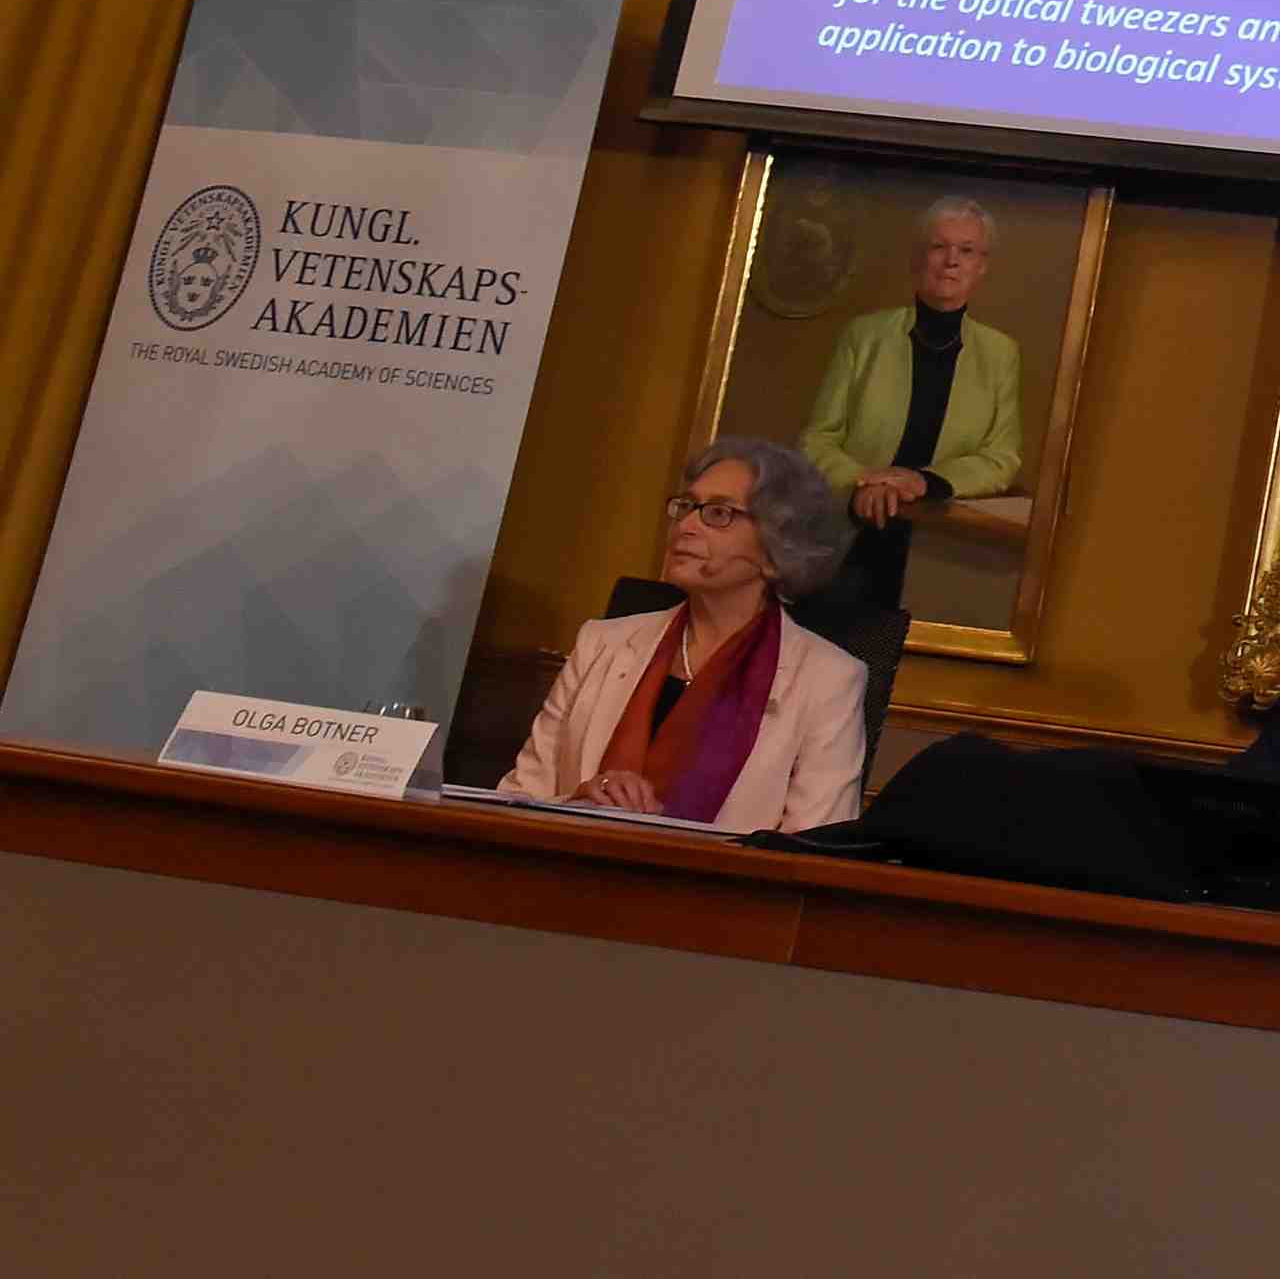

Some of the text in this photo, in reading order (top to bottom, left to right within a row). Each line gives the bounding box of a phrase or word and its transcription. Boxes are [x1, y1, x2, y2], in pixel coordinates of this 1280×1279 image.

[818, 24, 1003, 63] application
[1011, 38, 1047, 67] to
[1052, 38, 1222, 84] biological
[279, 200, 420, 246] KUNGL.
[251, 298, 512, 355] AKADEMIEN
[130, 342, 495, 395] THE ROYAL SWEDISH ACADEMY OF SCIENCES
[232, 708, 380, 745] OLGA BOTNER
